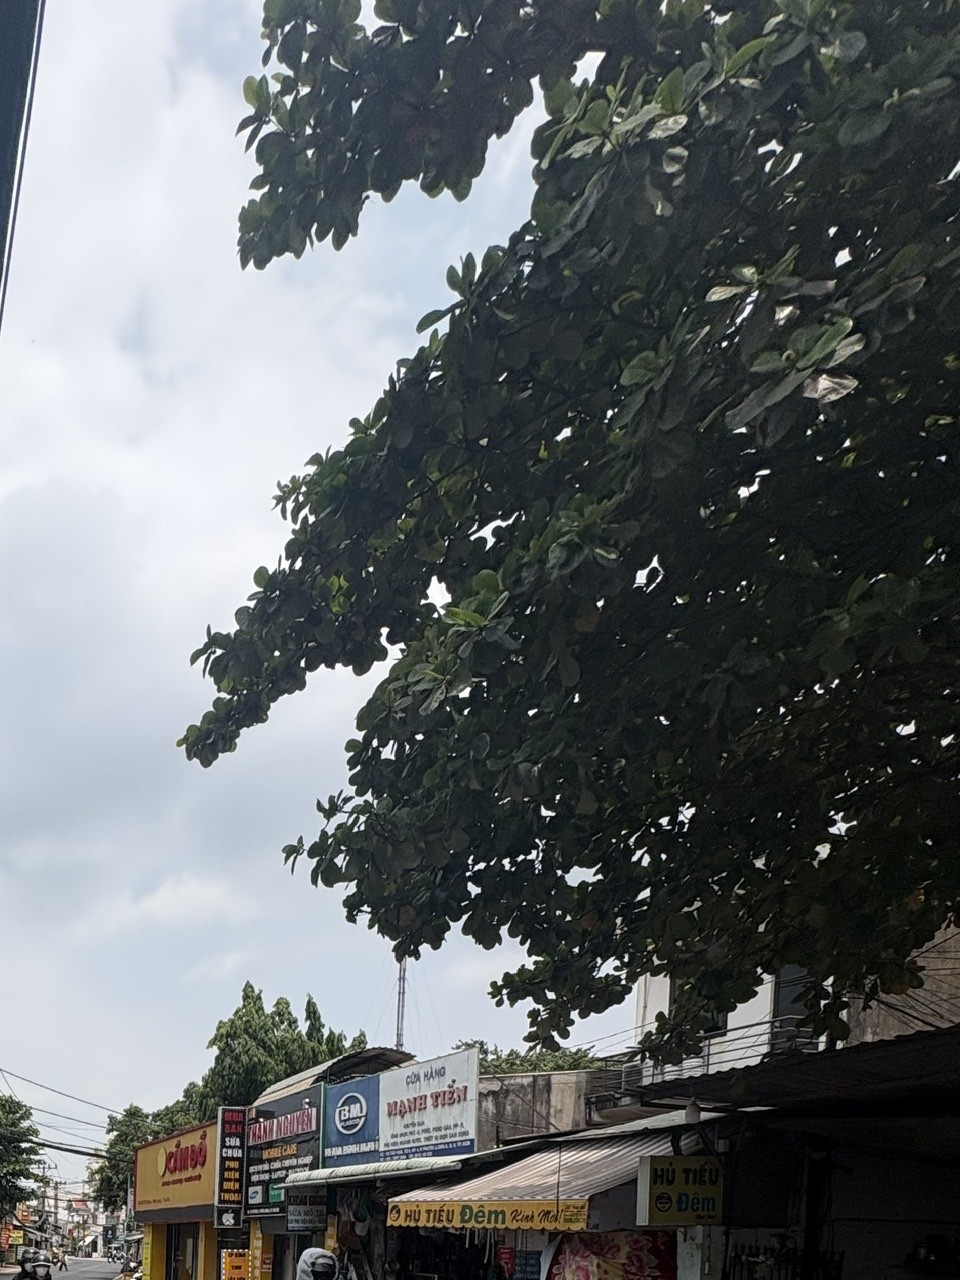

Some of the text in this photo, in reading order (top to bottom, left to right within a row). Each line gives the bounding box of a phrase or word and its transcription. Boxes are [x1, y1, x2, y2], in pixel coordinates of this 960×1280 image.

[387, 1094, 428, 1118] MẠNH
[676, 1192, 716, 1212] Đêm
[404, 1204, 421, 1224] HỦ
[425, 1204, 454, 1224] TIẾU
[460, 1204, 507, 1225] Đêm
